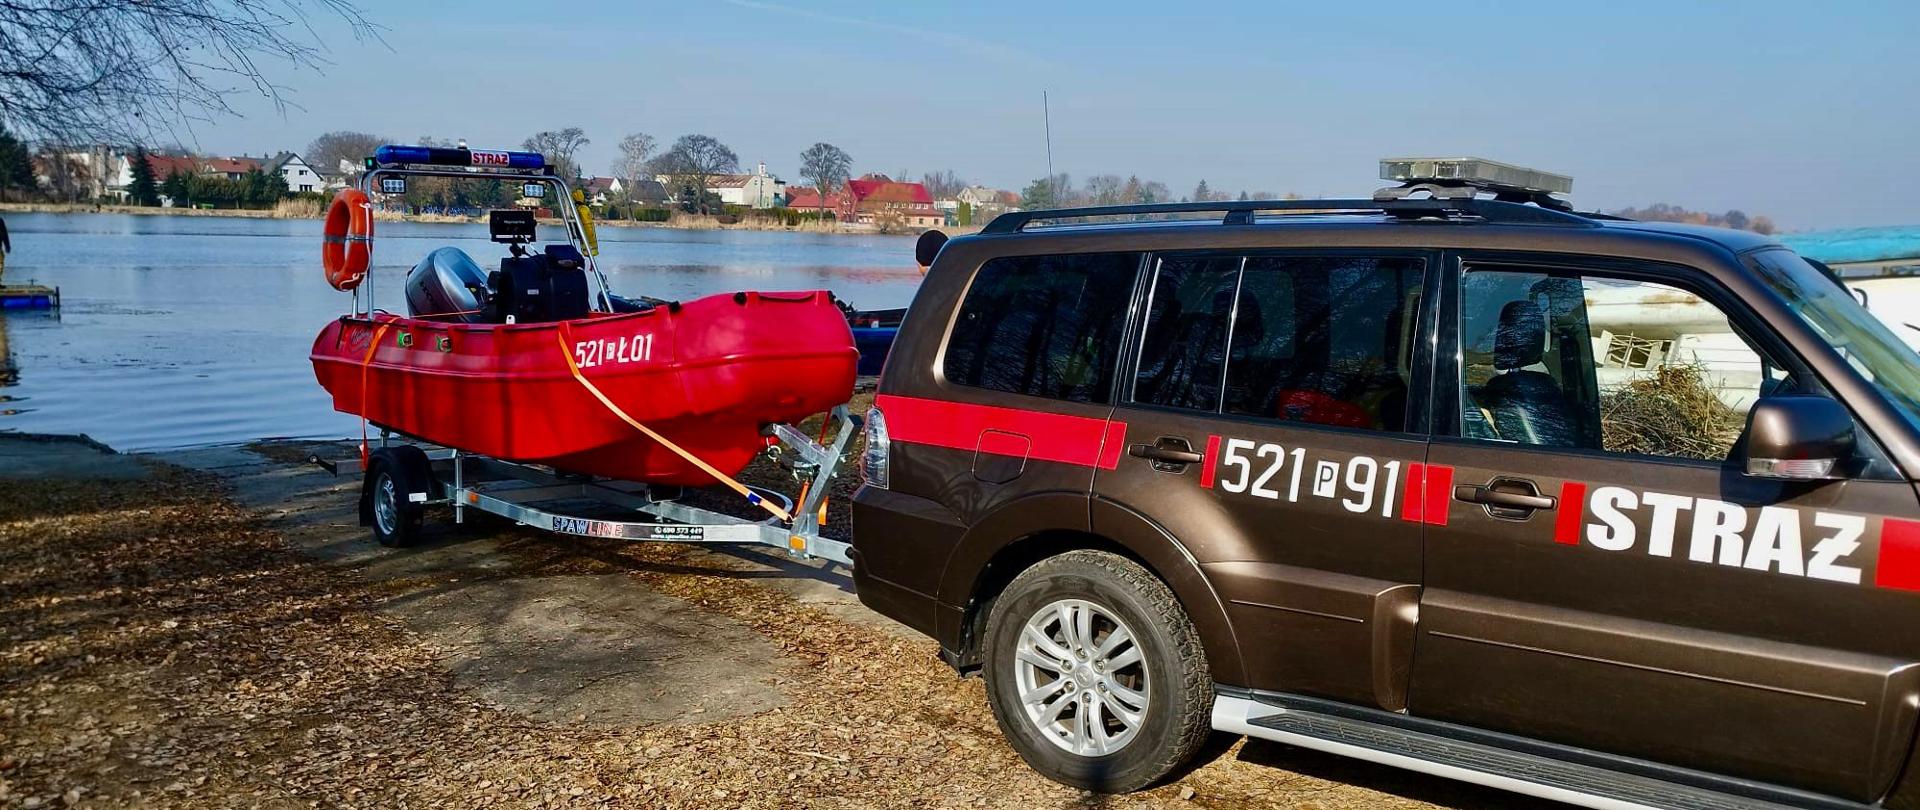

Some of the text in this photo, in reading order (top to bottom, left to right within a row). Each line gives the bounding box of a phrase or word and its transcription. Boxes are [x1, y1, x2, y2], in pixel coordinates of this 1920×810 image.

[575, 338, 604, 369] 521
[1221, 438, 1401, 518] 521 P 91
